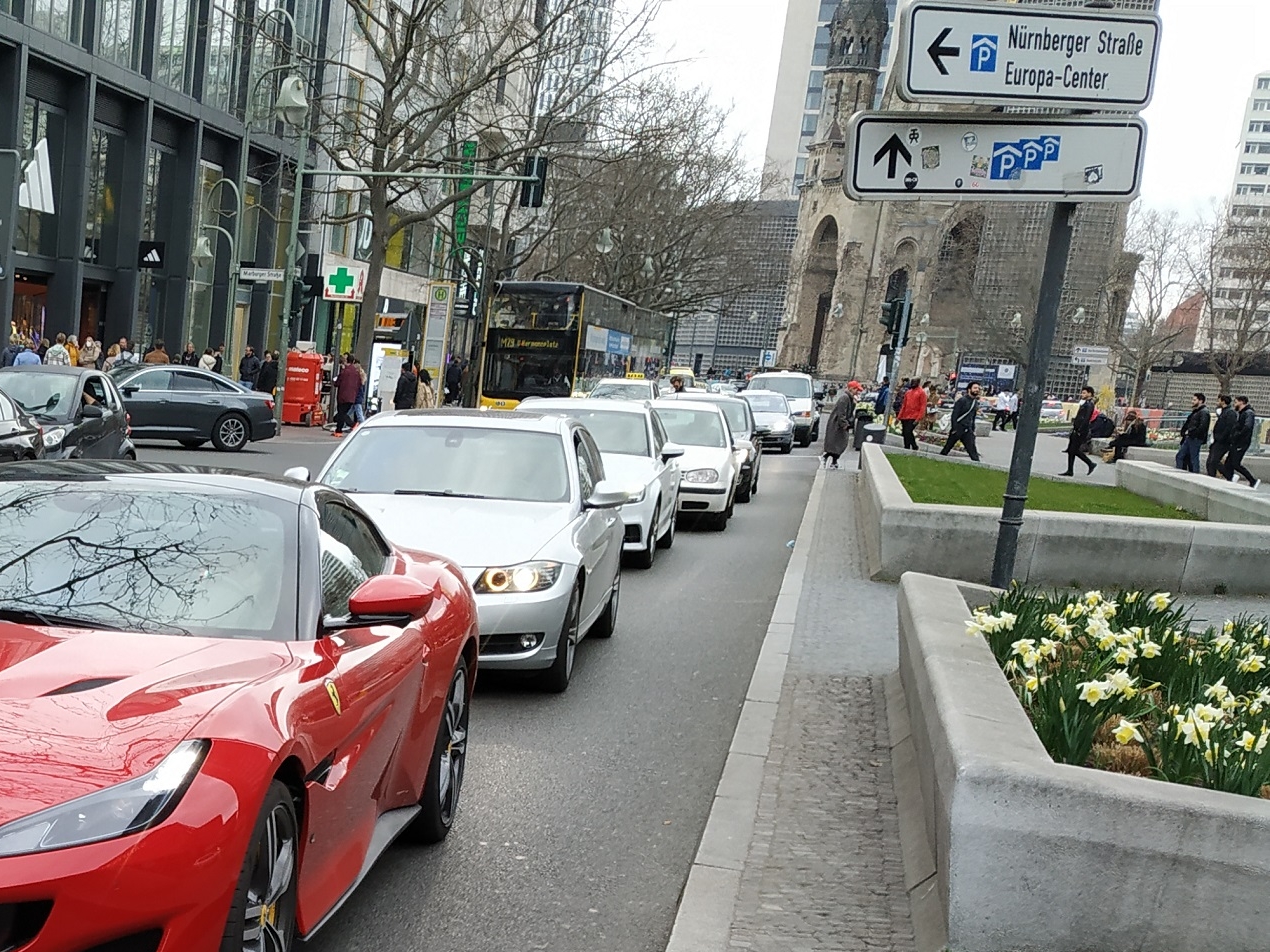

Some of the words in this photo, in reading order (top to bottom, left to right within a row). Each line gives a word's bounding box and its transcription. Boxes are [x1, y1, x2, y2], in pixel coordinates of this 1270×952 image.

[1008, 24, 1091, 58] Nürnberger
[1097, 30, 1144, 56] Straße
[1005, 61, 1109, 93] Europa-Center
[243, 270, 266, 278] Marburger
